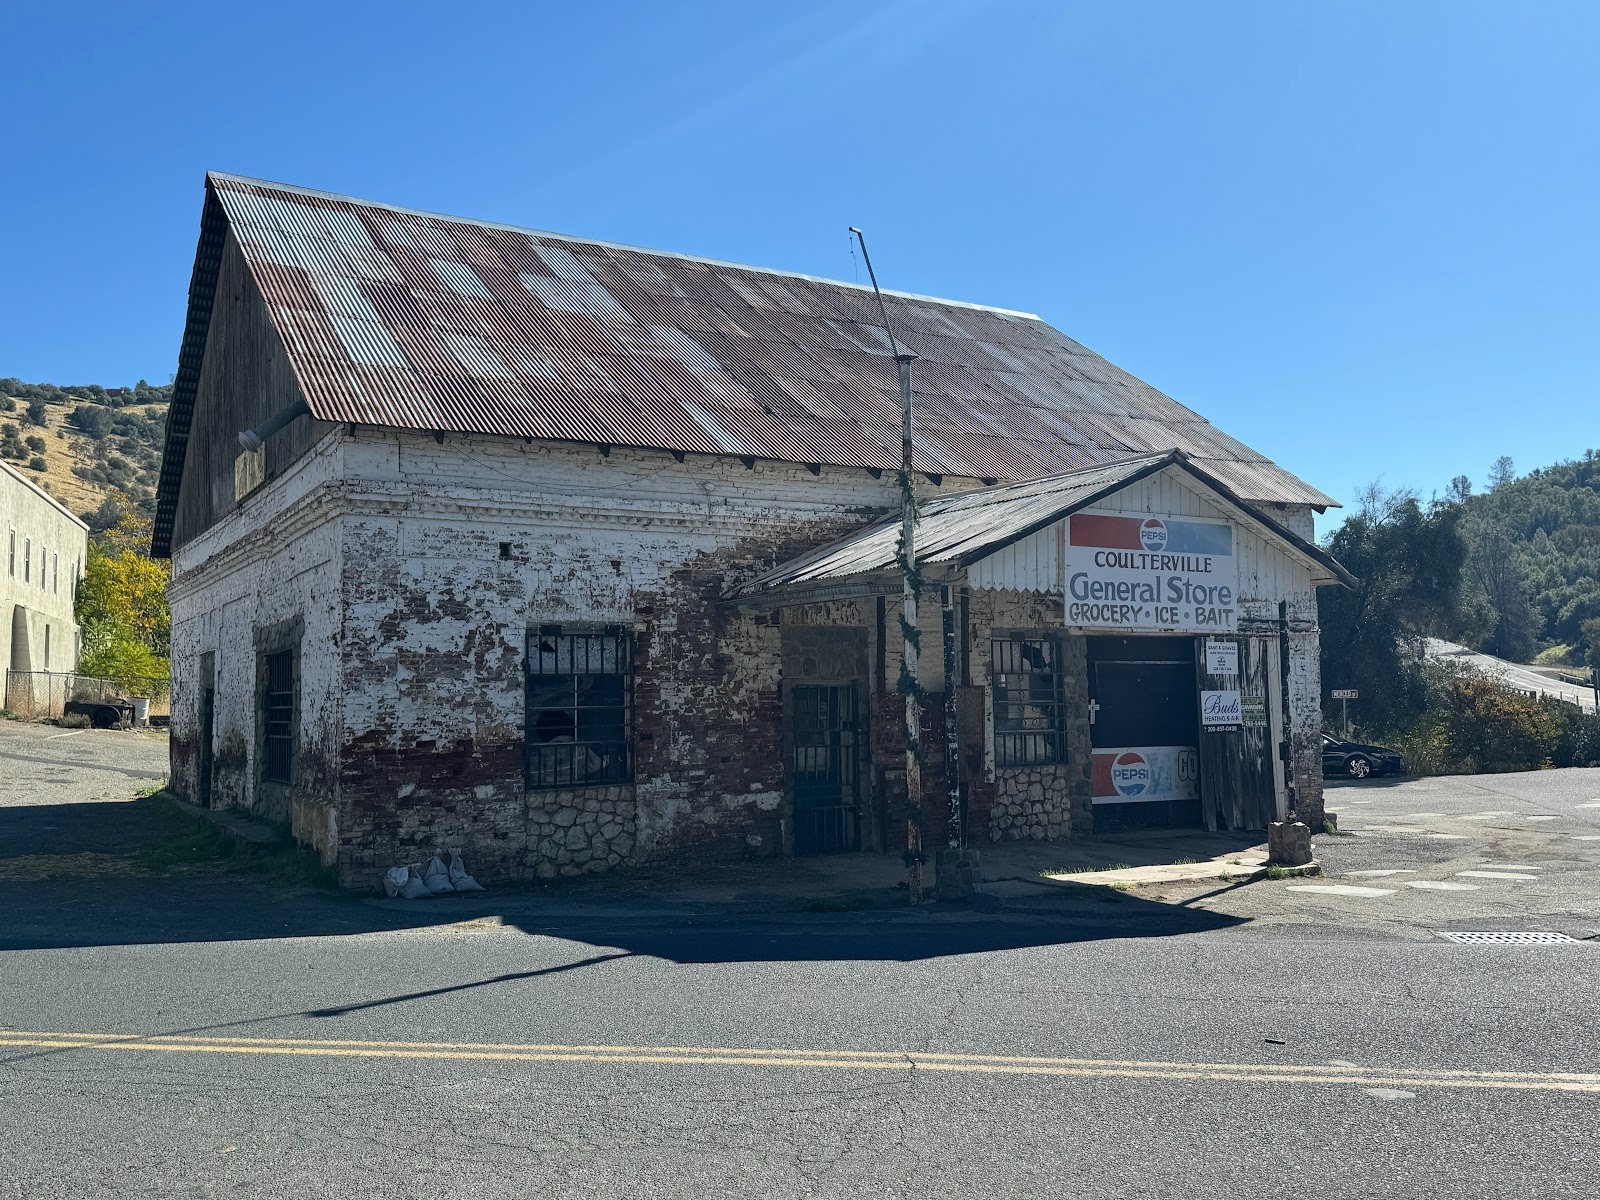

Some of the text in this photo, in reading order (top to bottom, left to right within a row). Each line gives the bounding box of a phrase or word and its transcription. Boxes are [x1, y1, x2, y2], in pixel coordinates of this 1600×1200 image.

[1141, 530, 1167, 541] PEPSI
[1094, 551, 1212, 573] COULTERVILLE
[1069, 572, 1232, 605] General Store
[1069, 603, 1234, 626] GROCERY ICE BAIT
[1204, 695, 1239, 714] Buds
[1113, 769, 1149, 780] PEPSI
